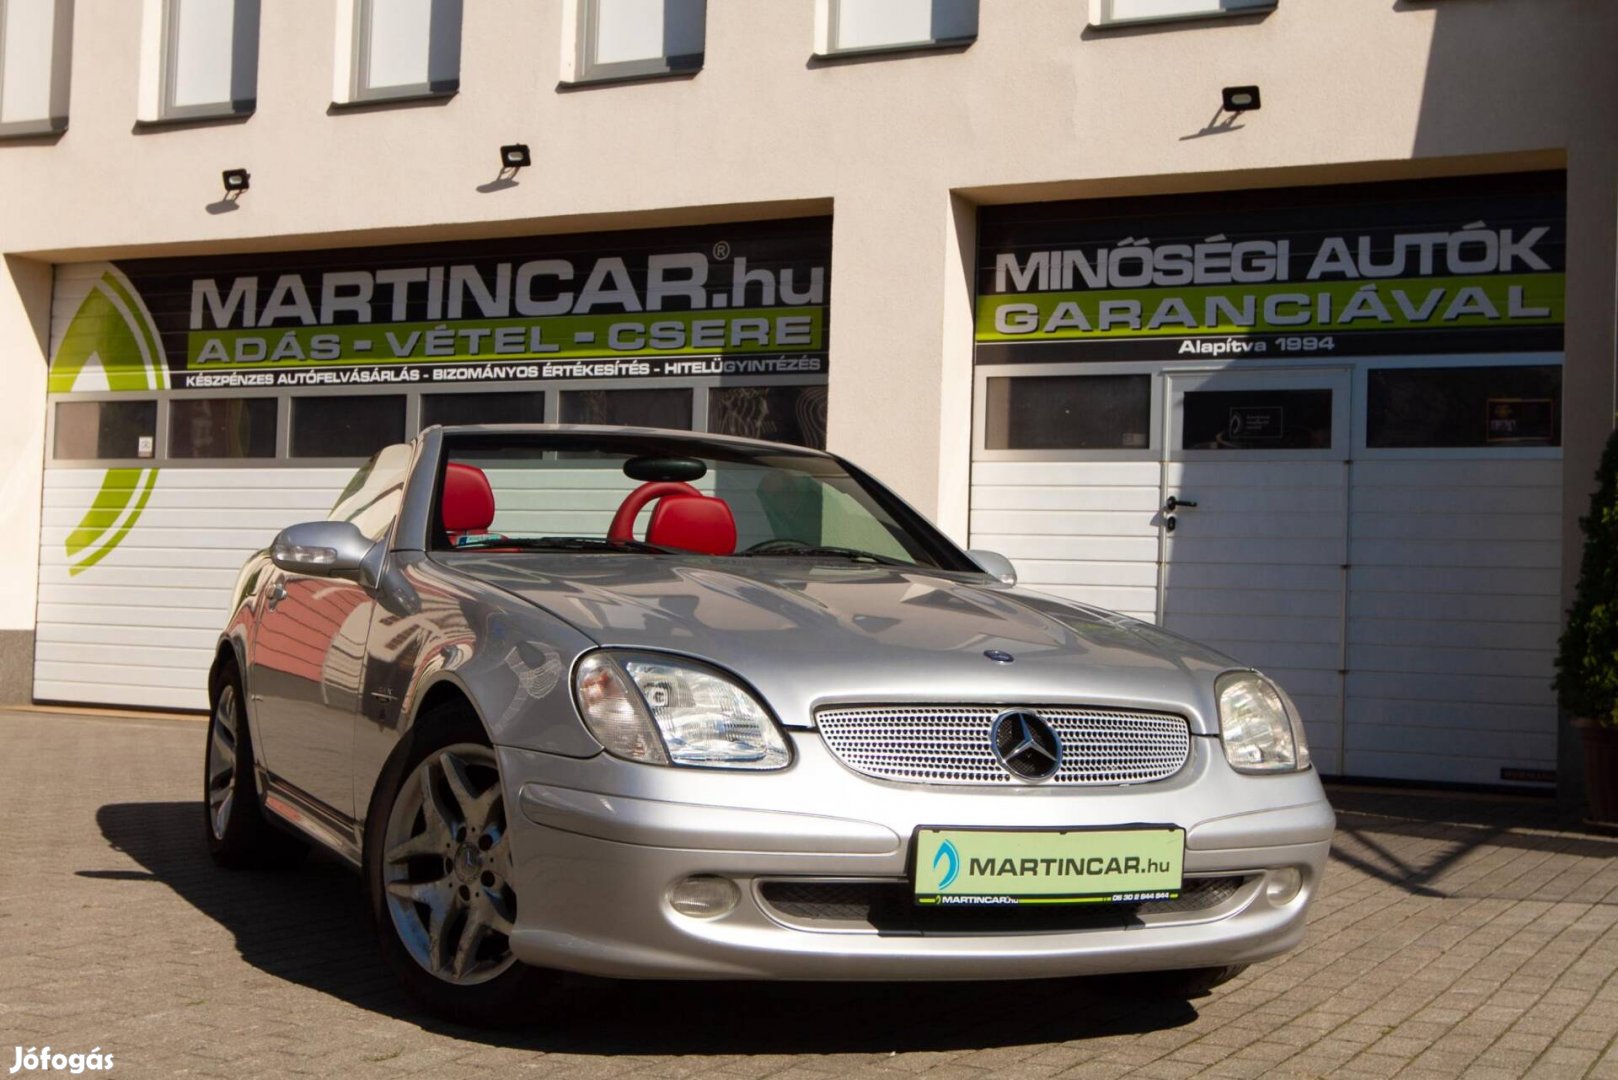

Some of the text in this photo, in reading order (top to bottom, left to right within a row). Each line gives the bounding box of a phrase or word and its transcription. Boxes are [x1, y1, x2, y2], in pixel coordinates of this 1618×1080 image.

[996, 220, 1552, 293] MINŐSÉGI AUTÓK
[995, 283, 1551, 334] GARANCIÁVAL
[197, 331, 341, 364] ADÁS
[385, 324, 560, 357] VÉTEL
[607, 316, 812, 350] CSERE
[1178, 336, 1336, 356] Alapítva 1994
[186, 368, 274, 388] KÉSZPÉNZES
[277, 367, 420, 385] AUTÓFELVÁSÁRLÁS
[433, 363, 539, 381] BIZOMÁNYOS
[542, 359, 650, 377] ÉRTÉKESÍTÉS
[664, 355, 821, 375] HITELÜGYINTÉZÉS
[969, 856, 1170, 877] MARTINCAR.hu
